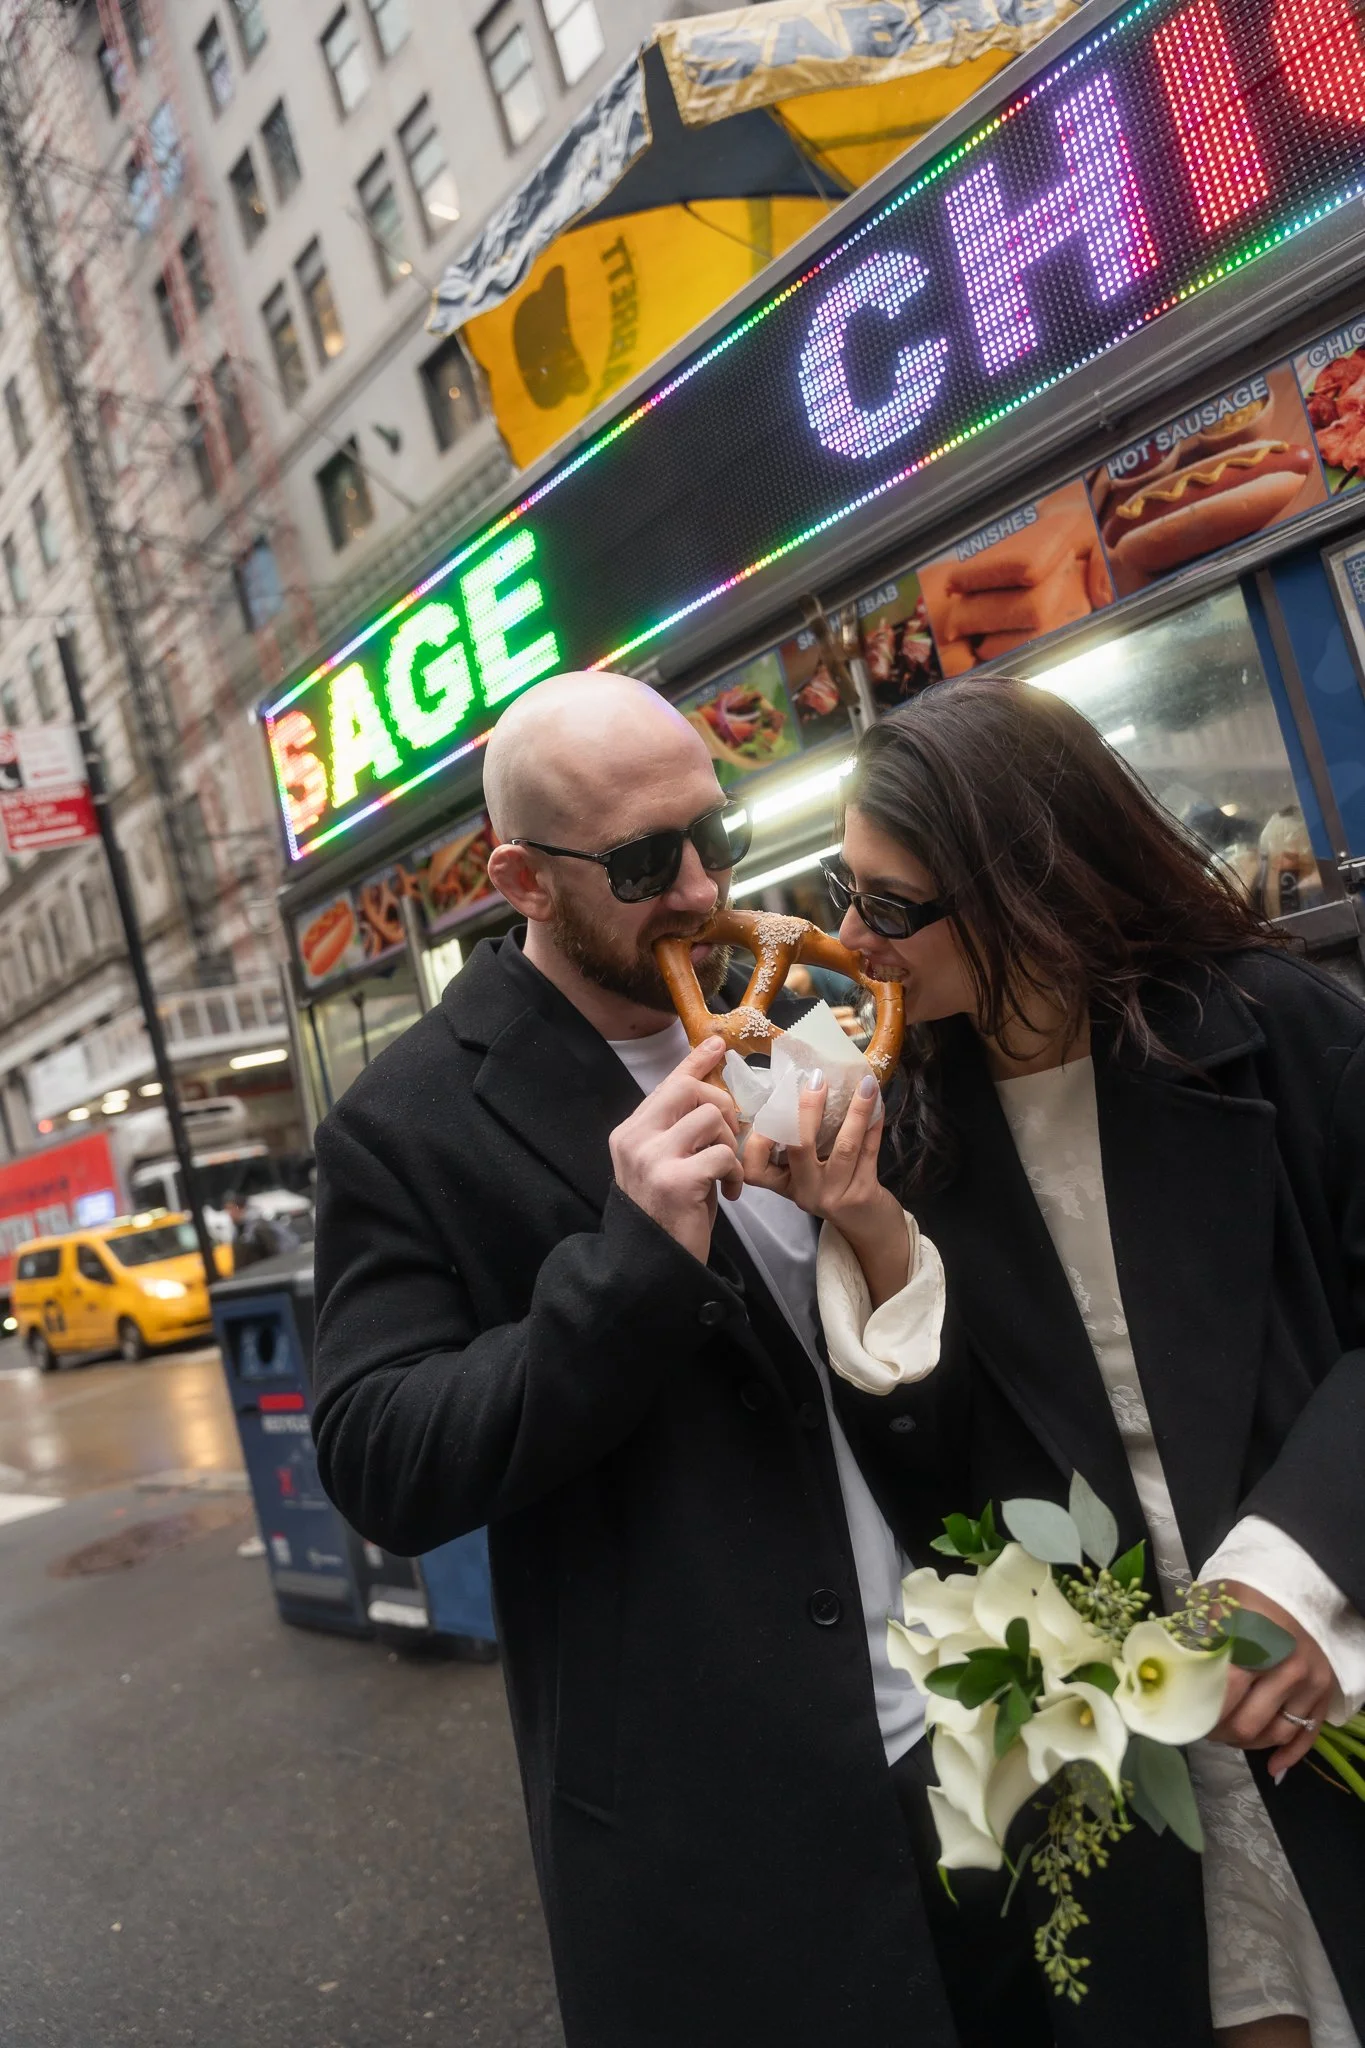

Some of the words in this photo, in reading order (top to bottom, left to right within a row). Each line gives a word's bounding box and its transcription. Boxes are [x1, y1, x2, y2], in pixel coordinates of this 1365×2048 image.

[1106, 443, 1151, 479] HOT
[1155, 376, 1269, 451] SAUSAGE
[957, 505, 1038, 562] KNISHES
